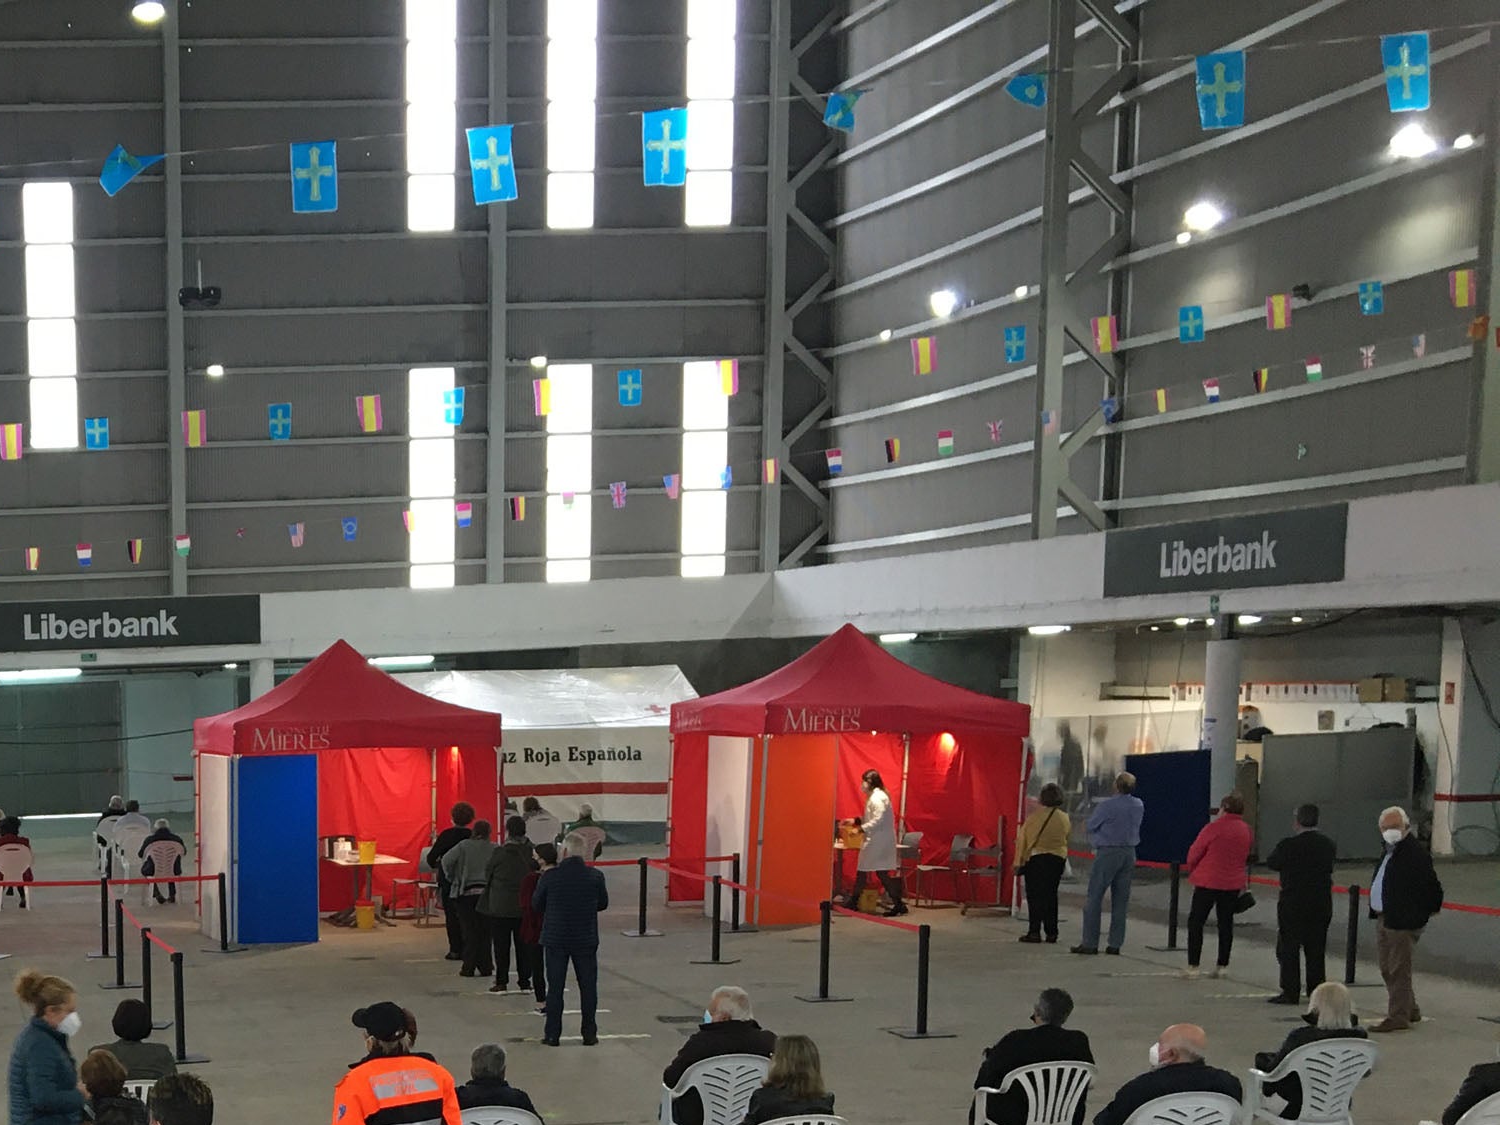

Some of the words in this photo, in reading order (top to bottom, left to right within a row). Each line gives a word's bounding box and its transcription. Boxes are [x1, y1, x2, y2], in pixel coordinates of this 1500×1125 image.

[1160, 530, 1277, 578] Liberbank
[24, 609, 179, 640] Liberbank
[784, 708, 862, 733] MIERES
[252, 728, 330, 752] MIERES
[524, 747, 561, 767] Roja
[568, 746, 642, 766] Española
